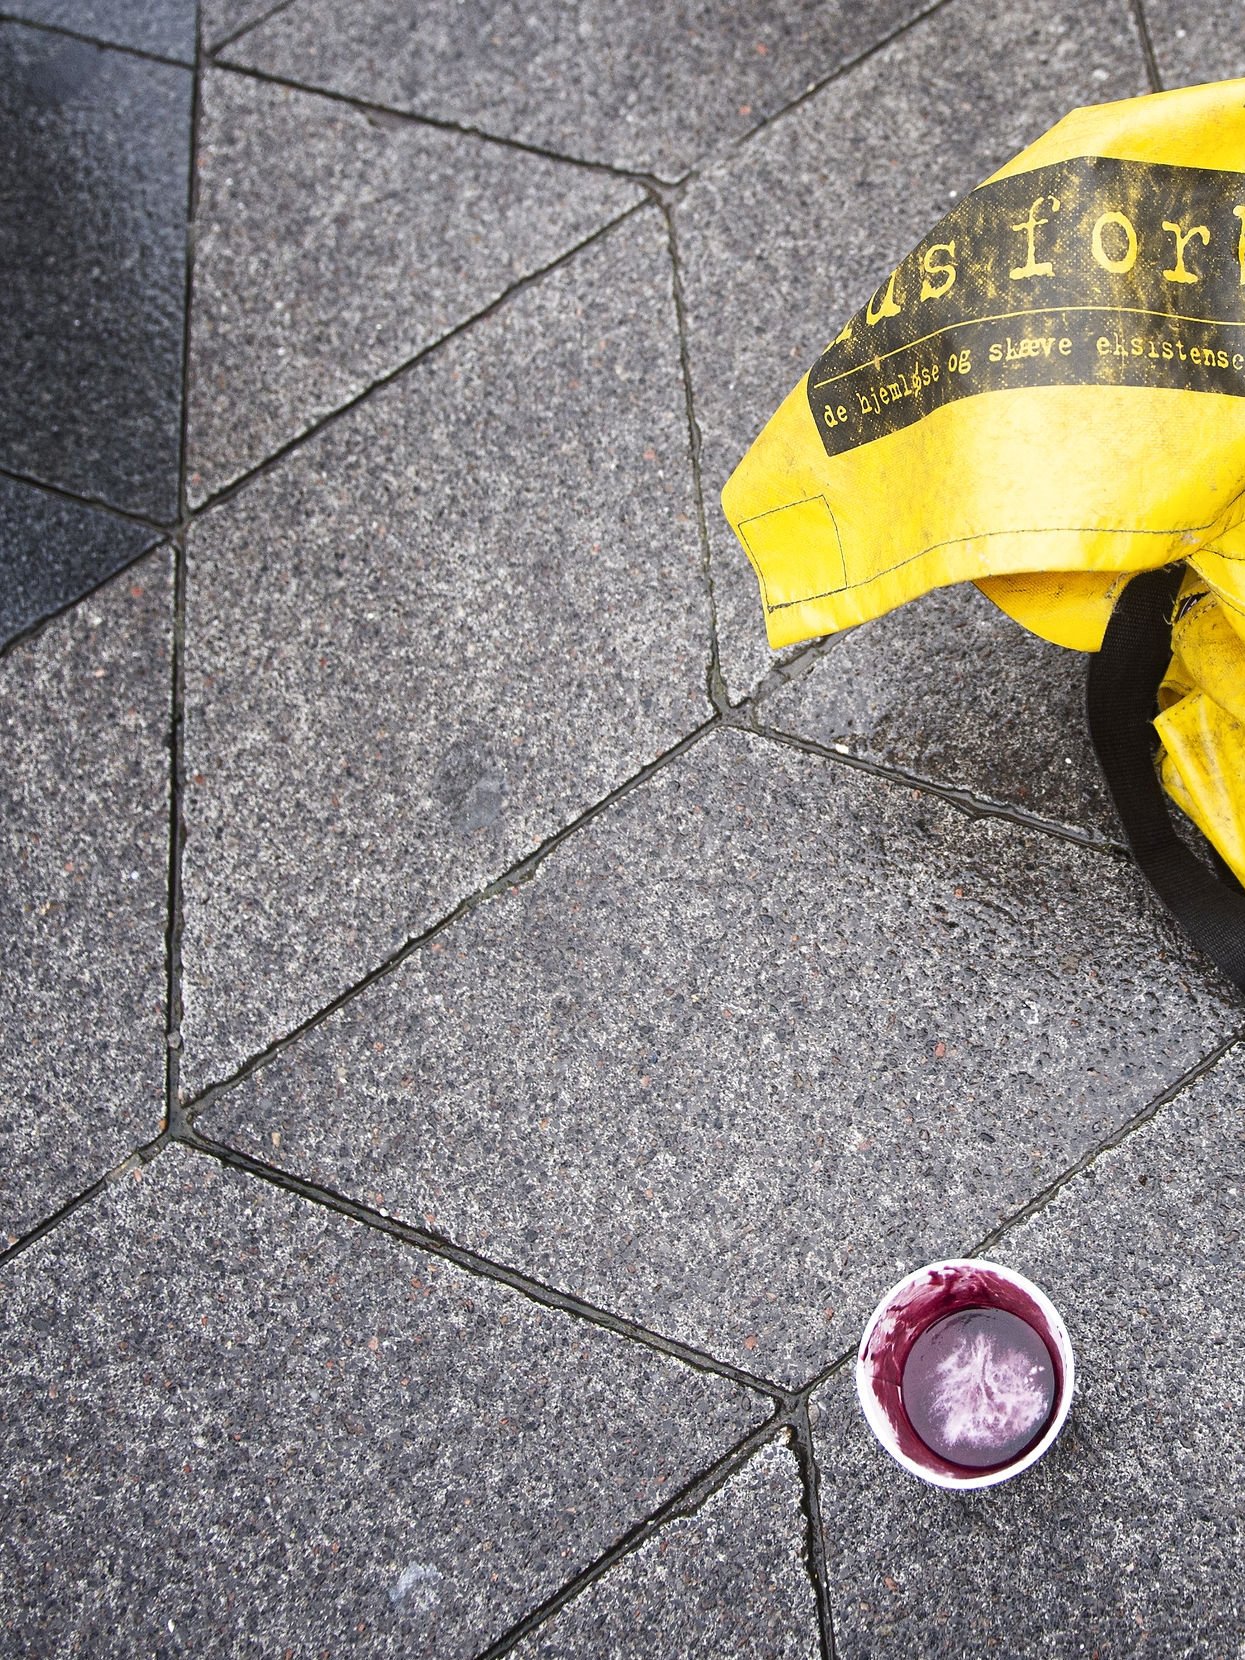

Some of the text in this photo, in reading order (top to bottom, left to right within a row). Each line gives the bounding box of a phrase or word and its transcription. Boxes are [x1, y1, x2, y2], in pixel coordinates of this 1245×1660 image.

[823, 404, 848, 428] de
[856, 363, 940, 415] hjemløse
[948, 349, 972, 374] og
